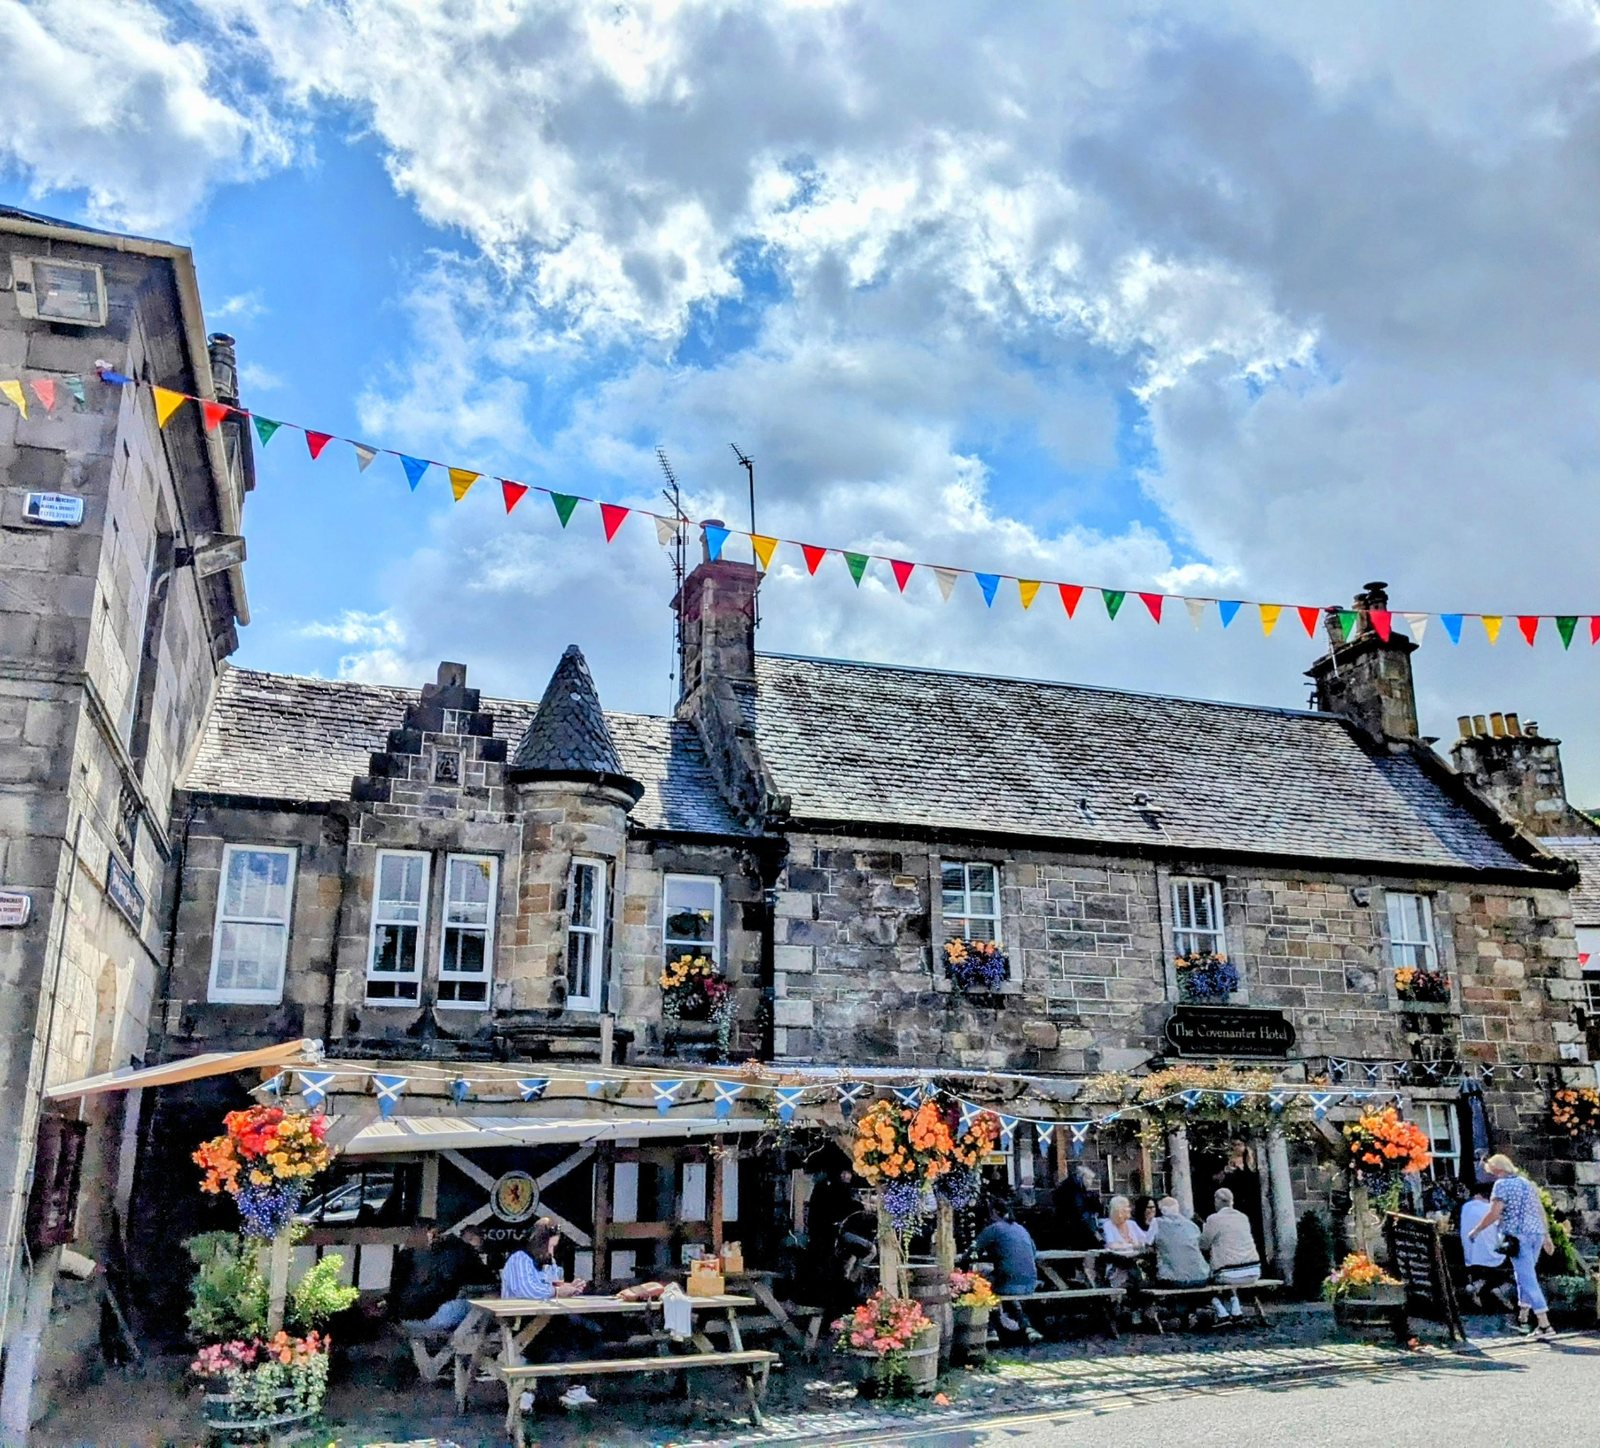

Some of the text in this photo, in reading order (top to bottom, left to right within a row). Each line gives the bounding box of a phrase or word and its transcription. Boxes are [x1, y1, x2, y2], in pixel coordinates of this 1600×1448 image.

[1172, 1021, 1288, 1041] The Covenanter Hotel
[483, 1228, 534, 1241] SCOTL
